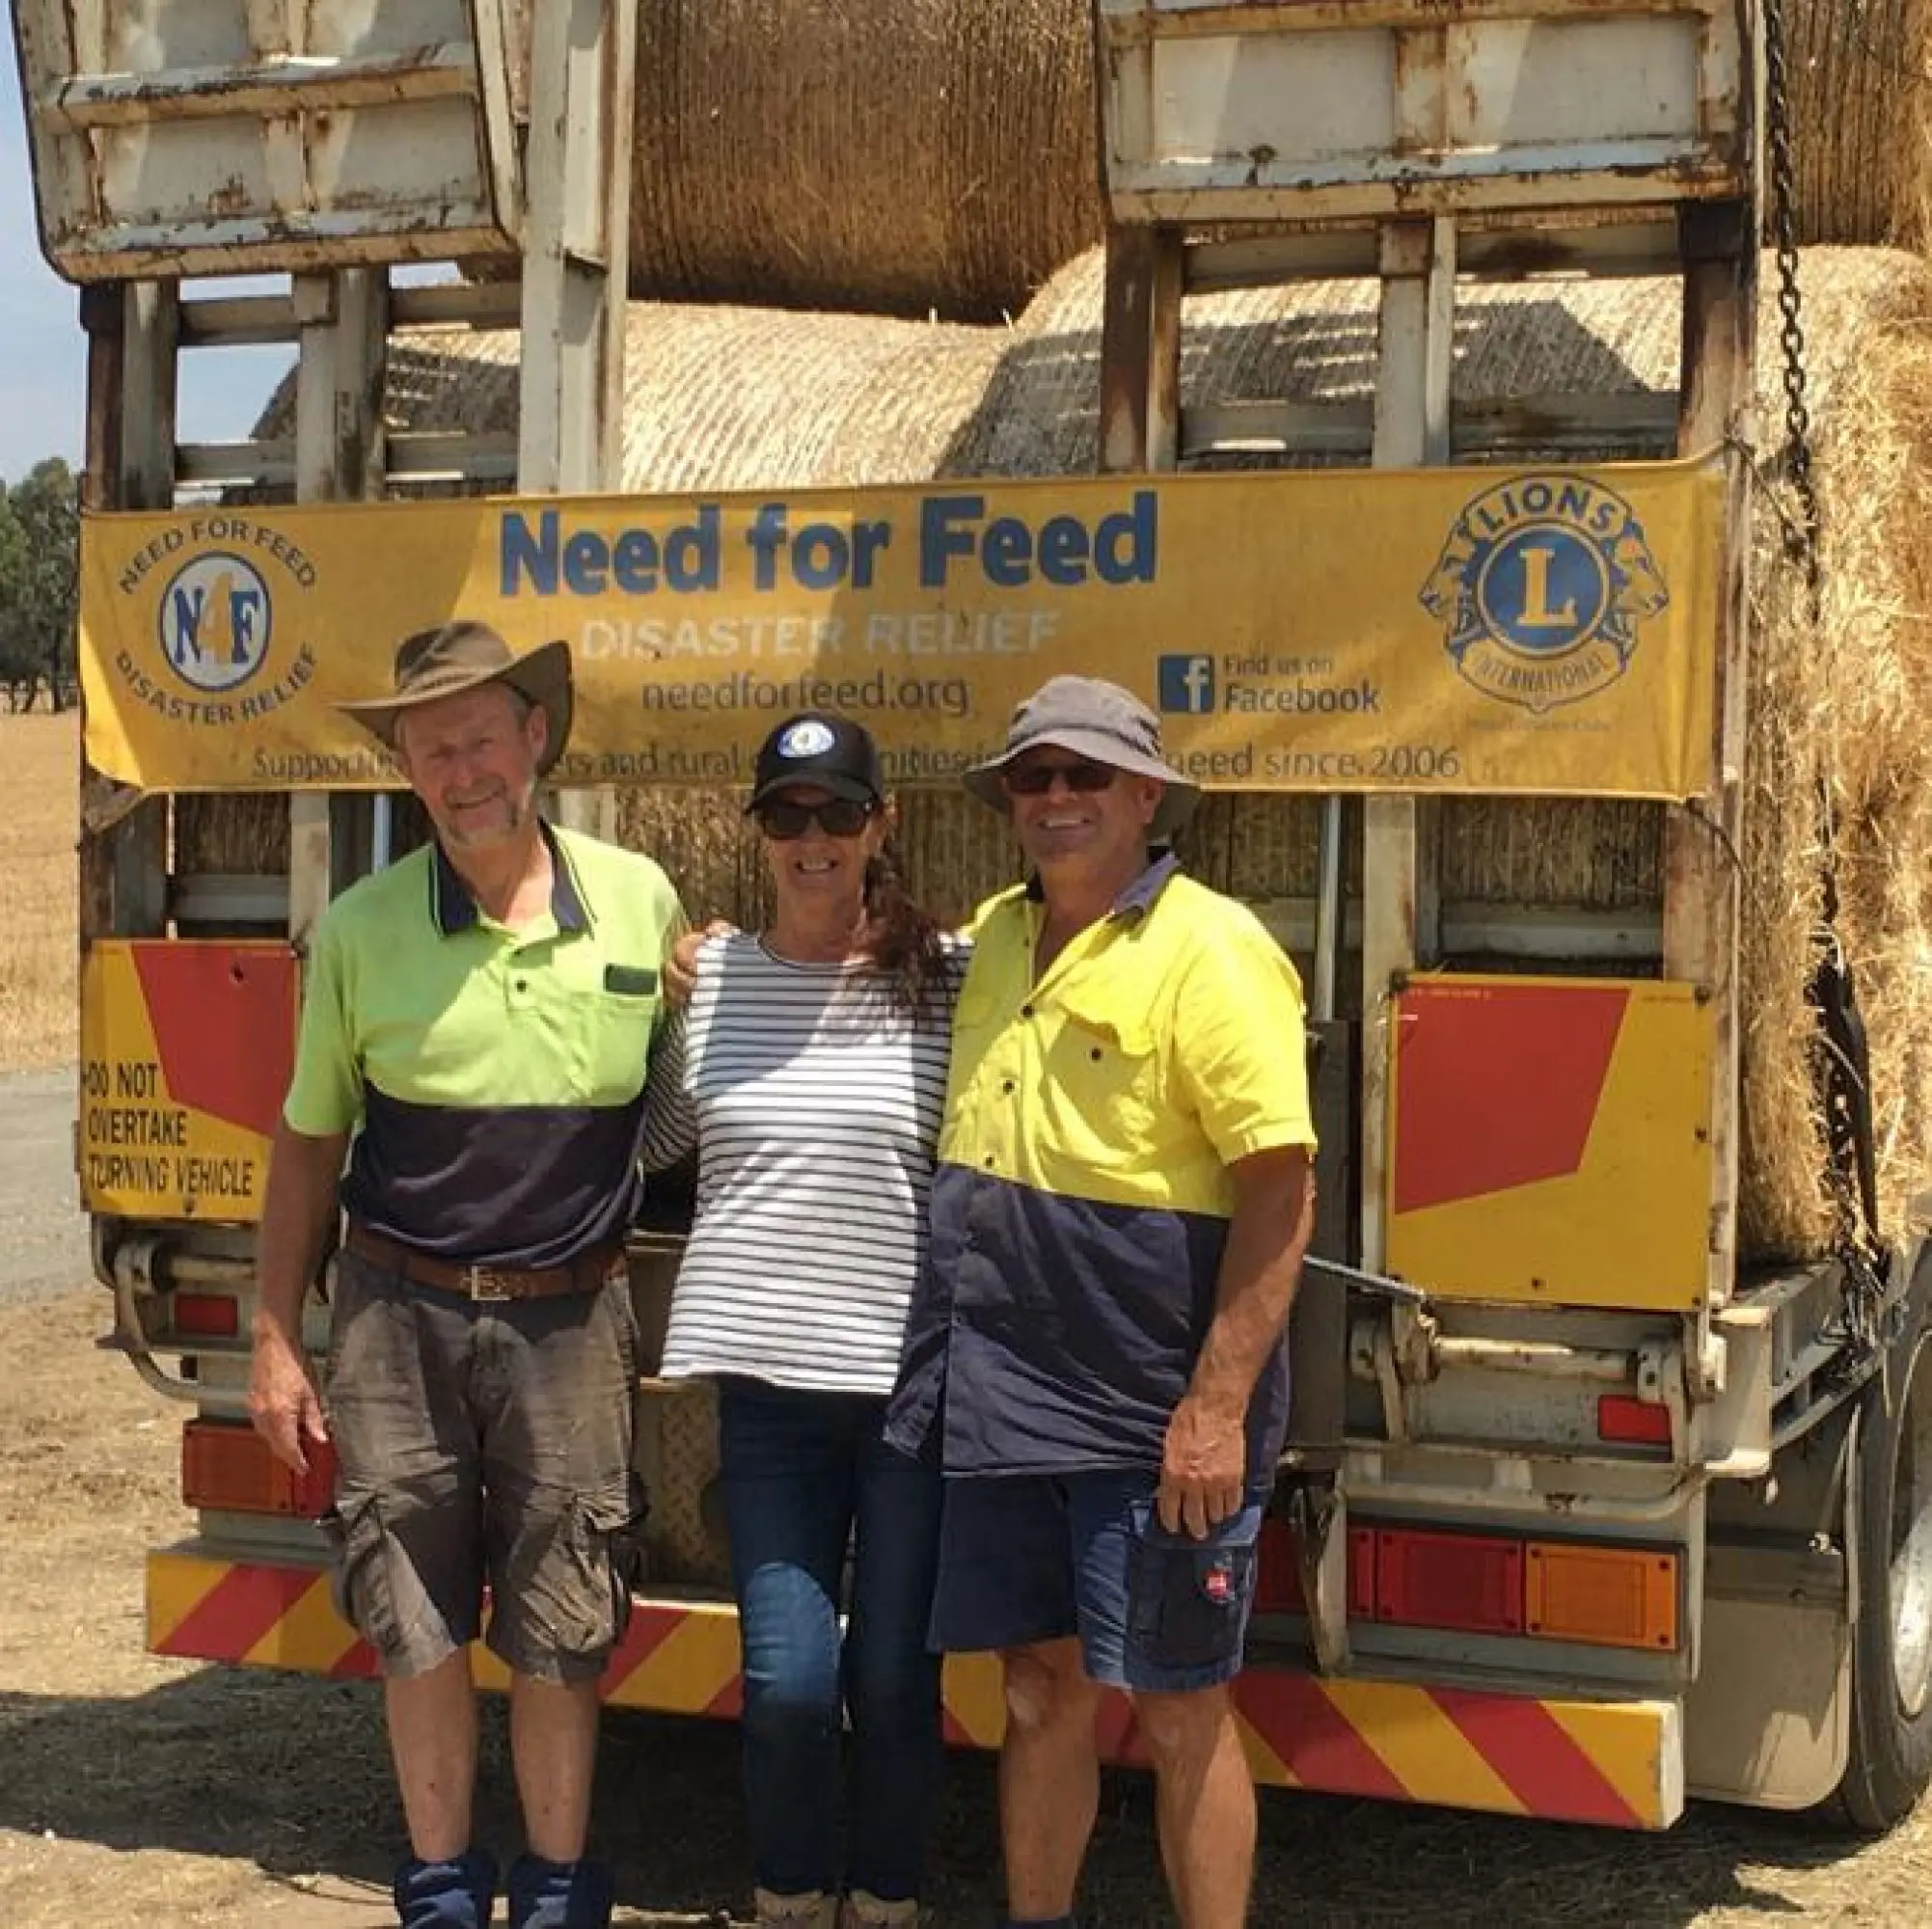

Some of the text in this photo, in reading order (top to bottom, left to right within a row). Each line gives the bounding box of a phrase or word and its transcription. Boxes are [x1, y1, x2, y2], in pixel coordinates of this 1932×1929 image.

[1476, 483, 1617, 531] LIONS
[119, 518, 316, 595] NEED FOR FEED
[500, 490, 1158, 597] Need for Feed
[1517, 548, 1579, 627] L
[582, 610, 1060, 661] DISASTER RELIEF
[116, 641, 317, 724] DISASTER RELIEF
[1223, 653, 1332, 675] Find us on
[641, 669, 971, 719] needforfeed.org
[1224, 678, 1382, 713] Facebook
[600, 740, 658, 774] and
[670, 740, 739, 774] rural
[1371, 745, 1461, 779] 2006
[88, 1060, 158, 1099] DO NOT
[89, 1107, 188, 1147] OVERTAKE
[88, 1154, 255, 1197] TURNING VEHICLE
